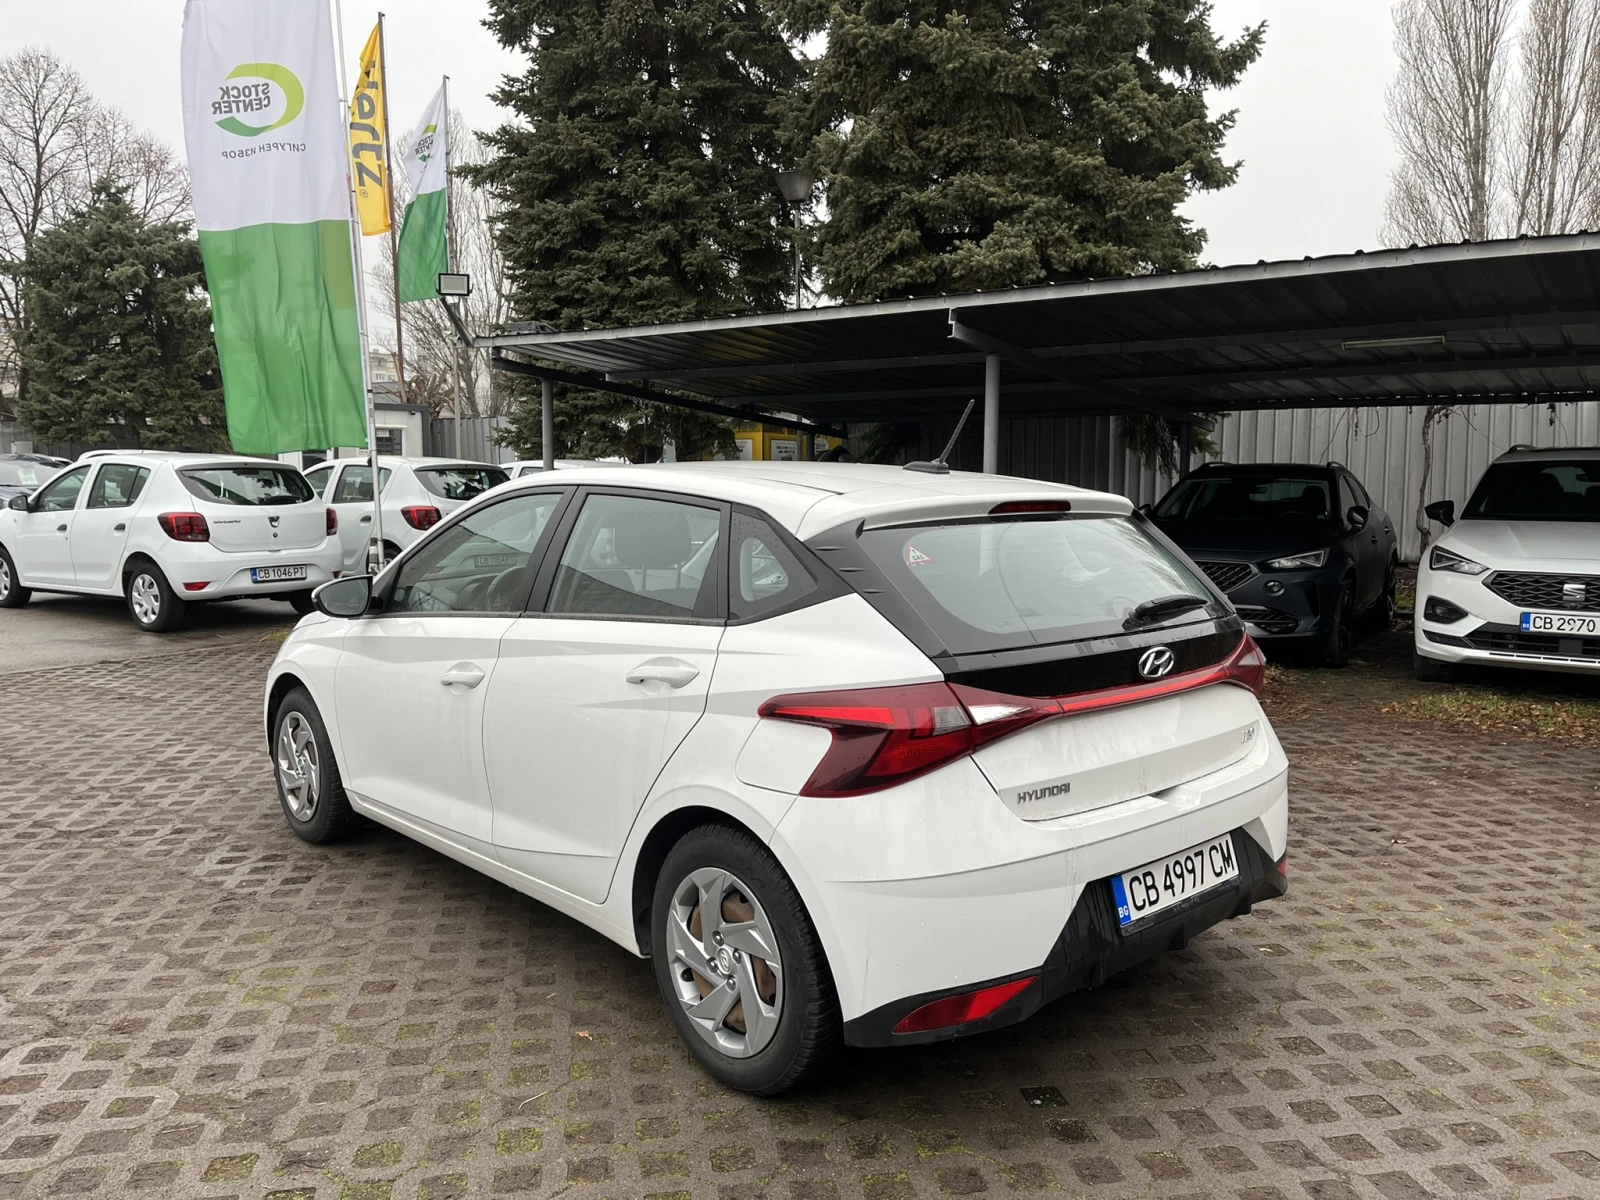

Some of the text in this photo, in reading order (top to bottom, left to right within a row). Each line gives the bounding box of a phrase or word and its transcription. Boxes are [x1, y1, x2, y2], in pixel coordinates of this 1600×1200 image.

[258, 566, 304, 579] CB 1046 PT
[1533, 616, 1596, 633] CB 2970
[1017, 782, 1070, 805] HYUNDAI
[1129, 870, 1160, 912] CB
[1163, 850, 1205, 897] 4997
[1208, 839, 1235, 878] CM
[1117, 905, 1129, 919] BG
